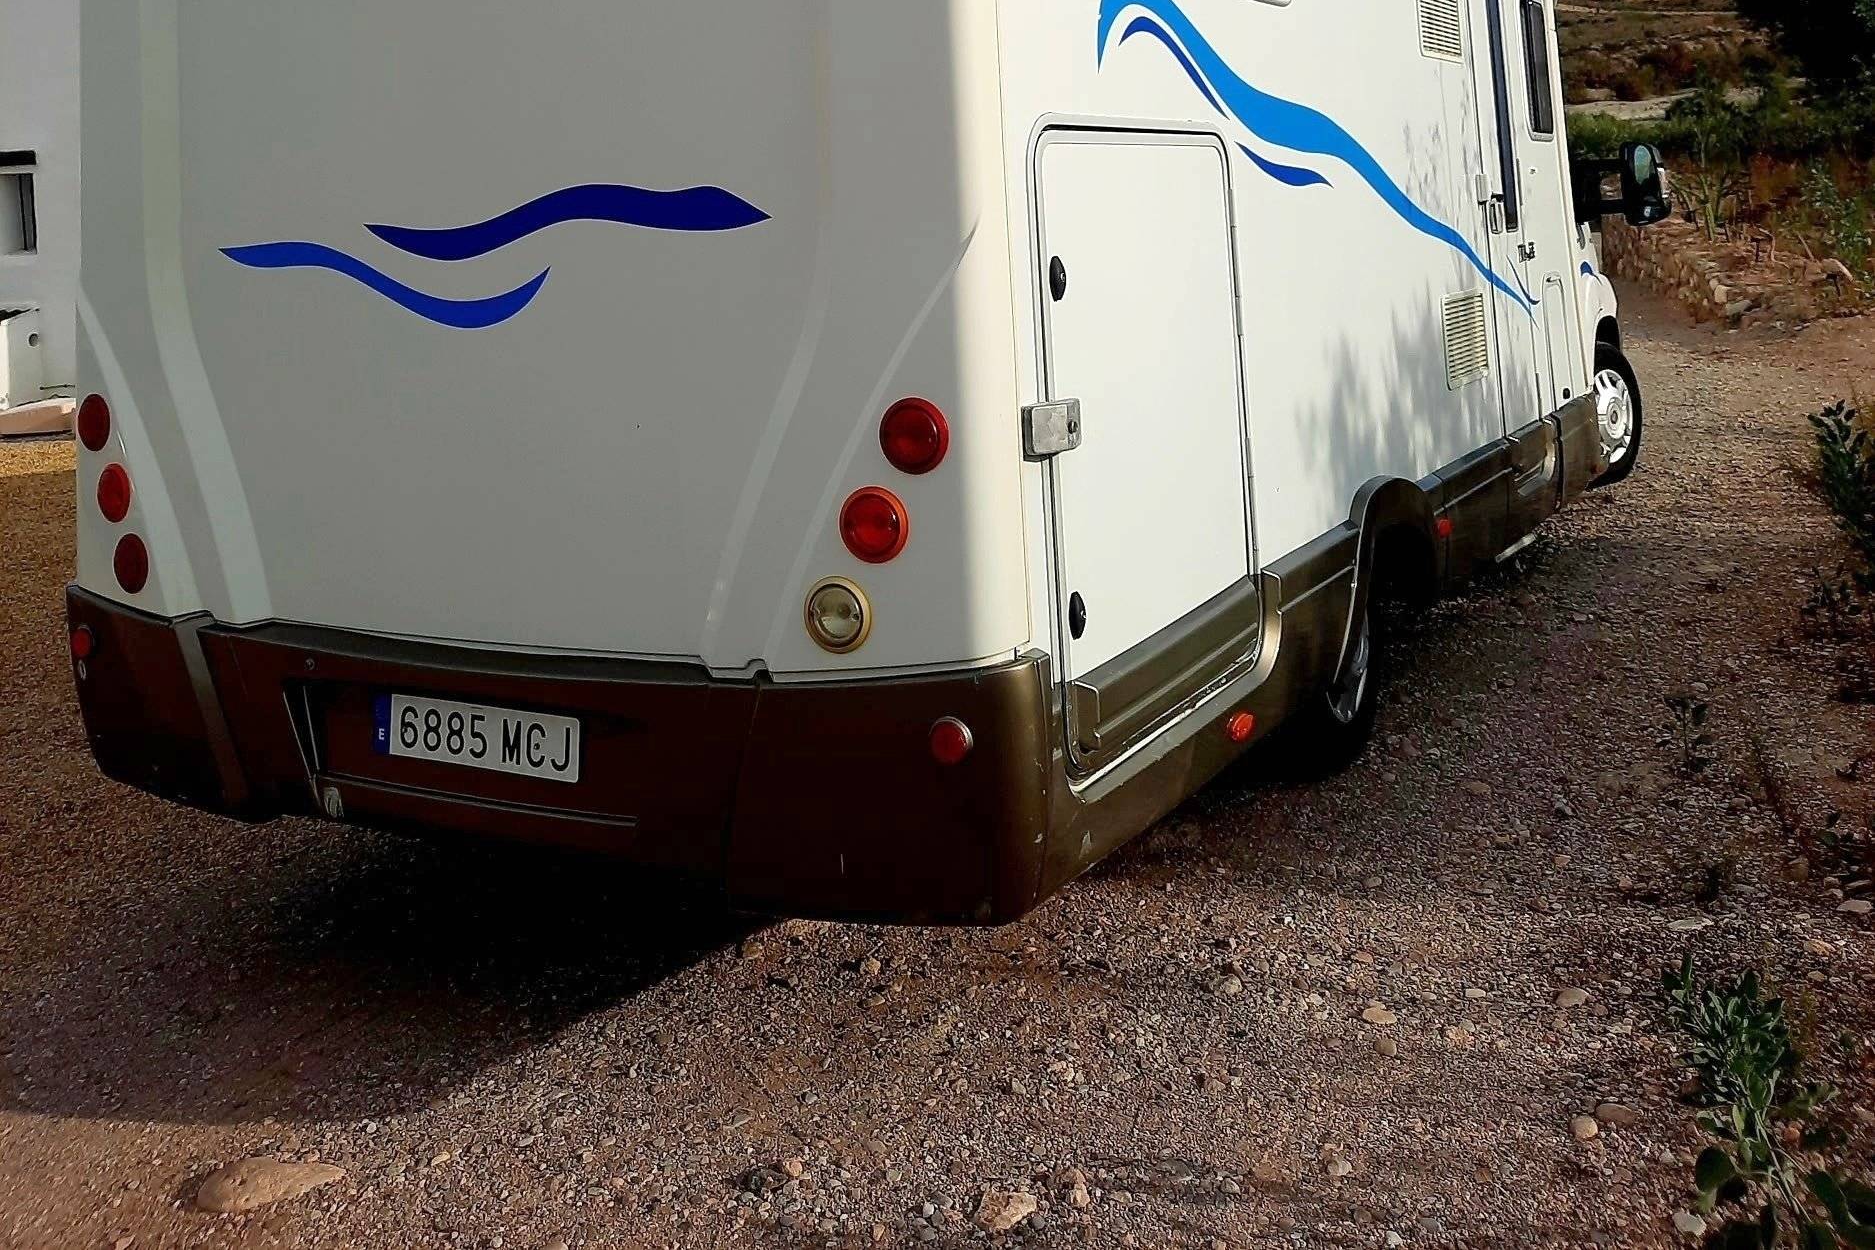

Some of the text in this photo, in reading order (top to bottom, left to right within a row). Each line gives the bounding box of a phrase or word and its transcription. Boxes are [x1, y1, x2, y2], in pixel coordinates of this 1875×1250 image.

[378, 728, 385, 740] E
[400, 705, 571, 772] 6885 MCJ
